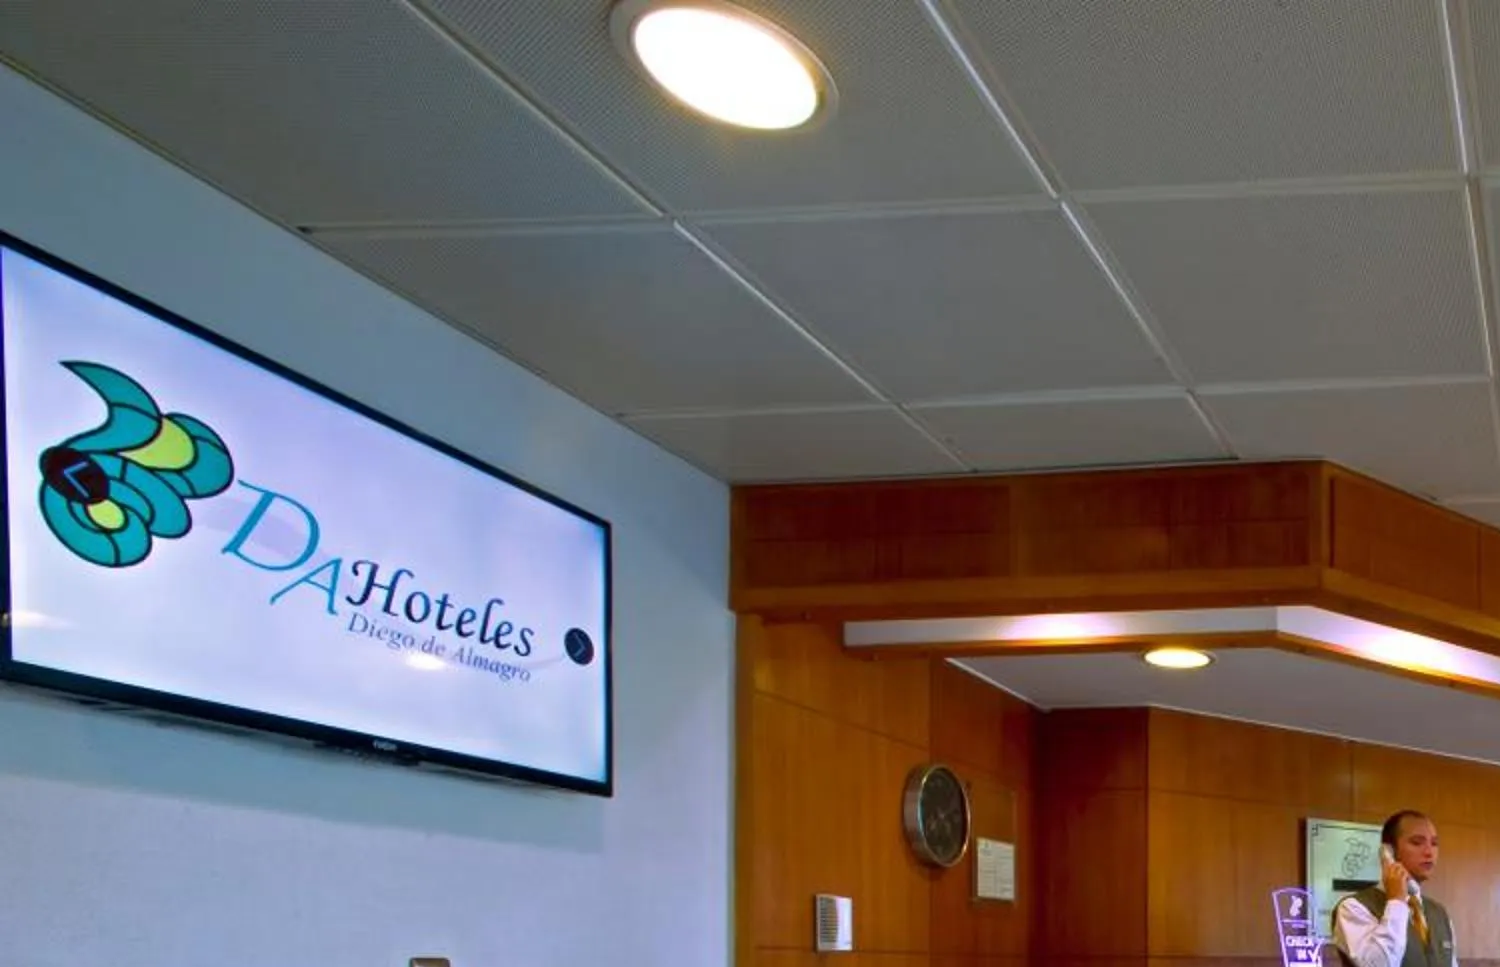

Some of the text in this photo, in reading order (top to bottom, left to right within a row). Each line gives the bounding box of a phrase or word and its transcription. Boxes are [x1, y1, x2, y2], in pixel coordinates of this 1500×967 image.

[345, 559, 535, 657] Hoteles
[347, 612, 532, 683] Diego de Almagro
